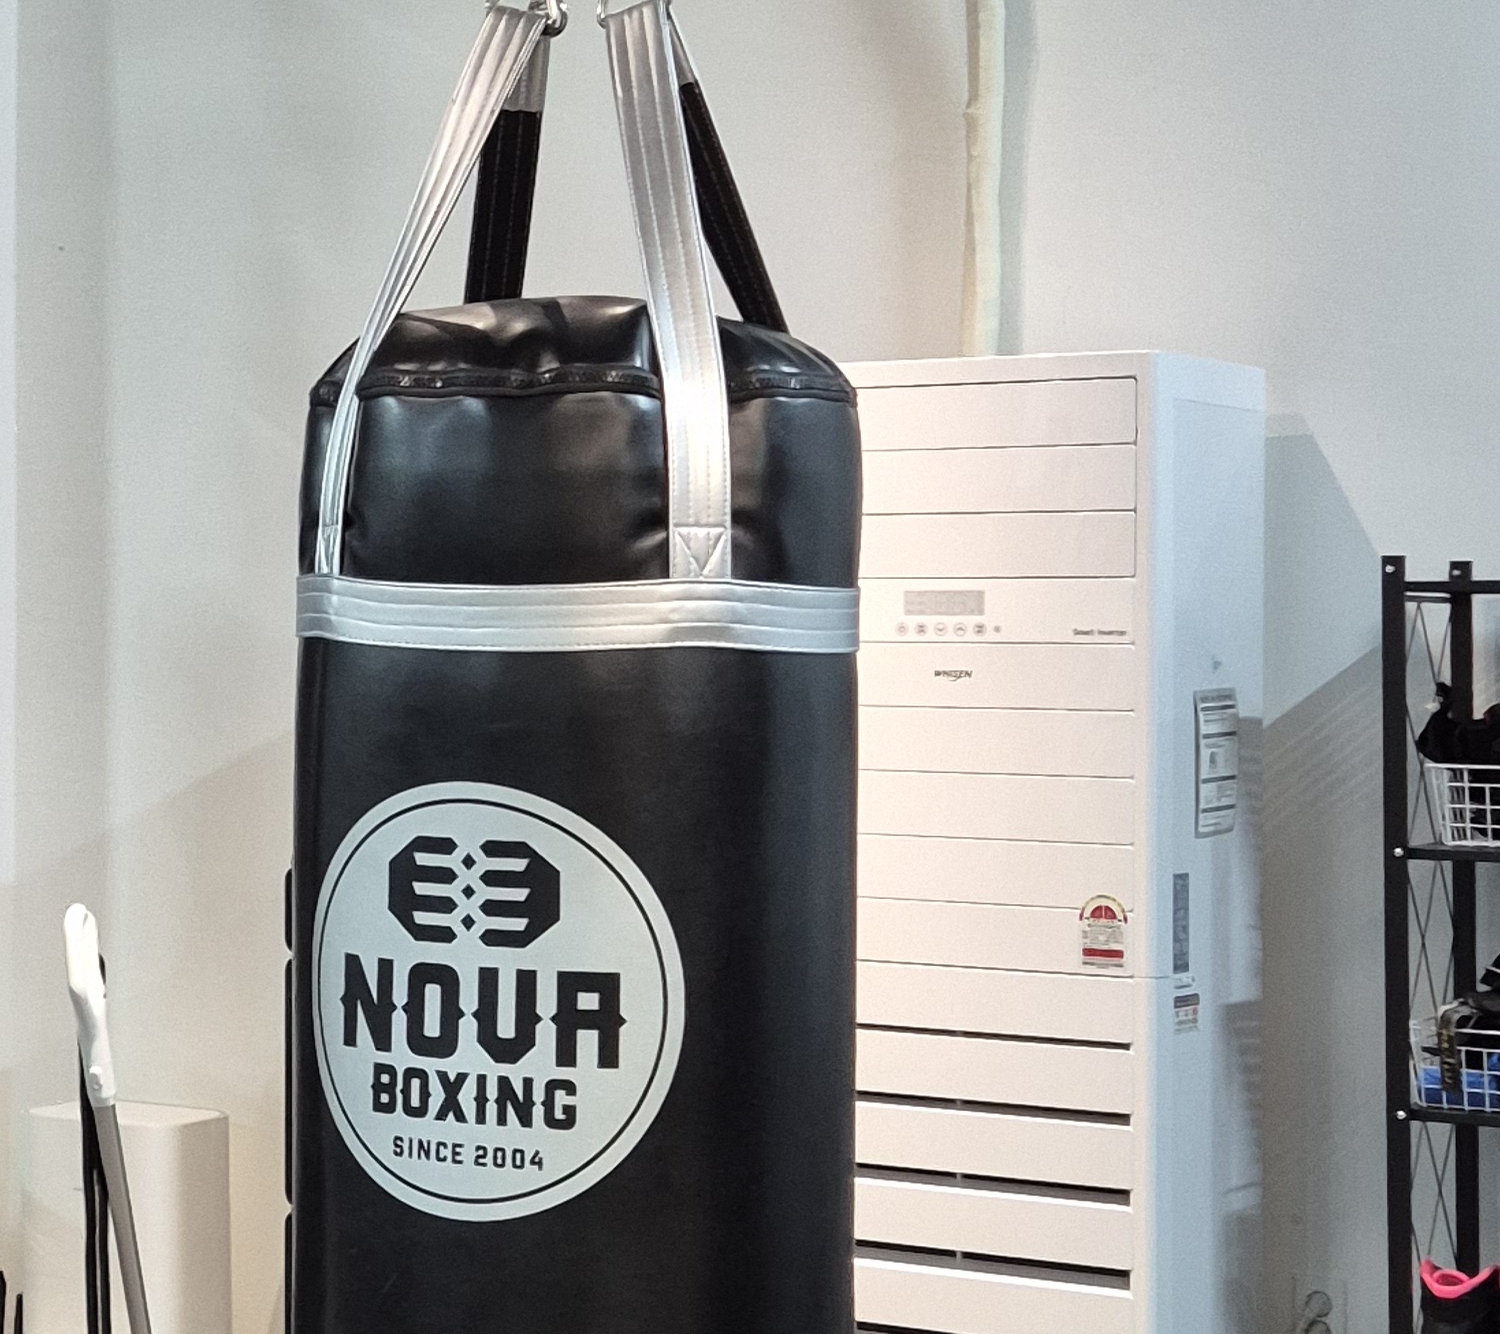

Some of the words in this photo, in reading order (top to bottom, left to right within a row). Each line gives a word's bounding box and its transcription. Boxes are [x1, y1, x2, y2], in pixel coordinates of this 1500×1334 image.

[341, 953, 627, 1069] NOVA
[371, 1062, 577, 1130] BOXING
[393, 1136, 464, 1164] SINCE
[474, 1145, 544, 1171] 2004
